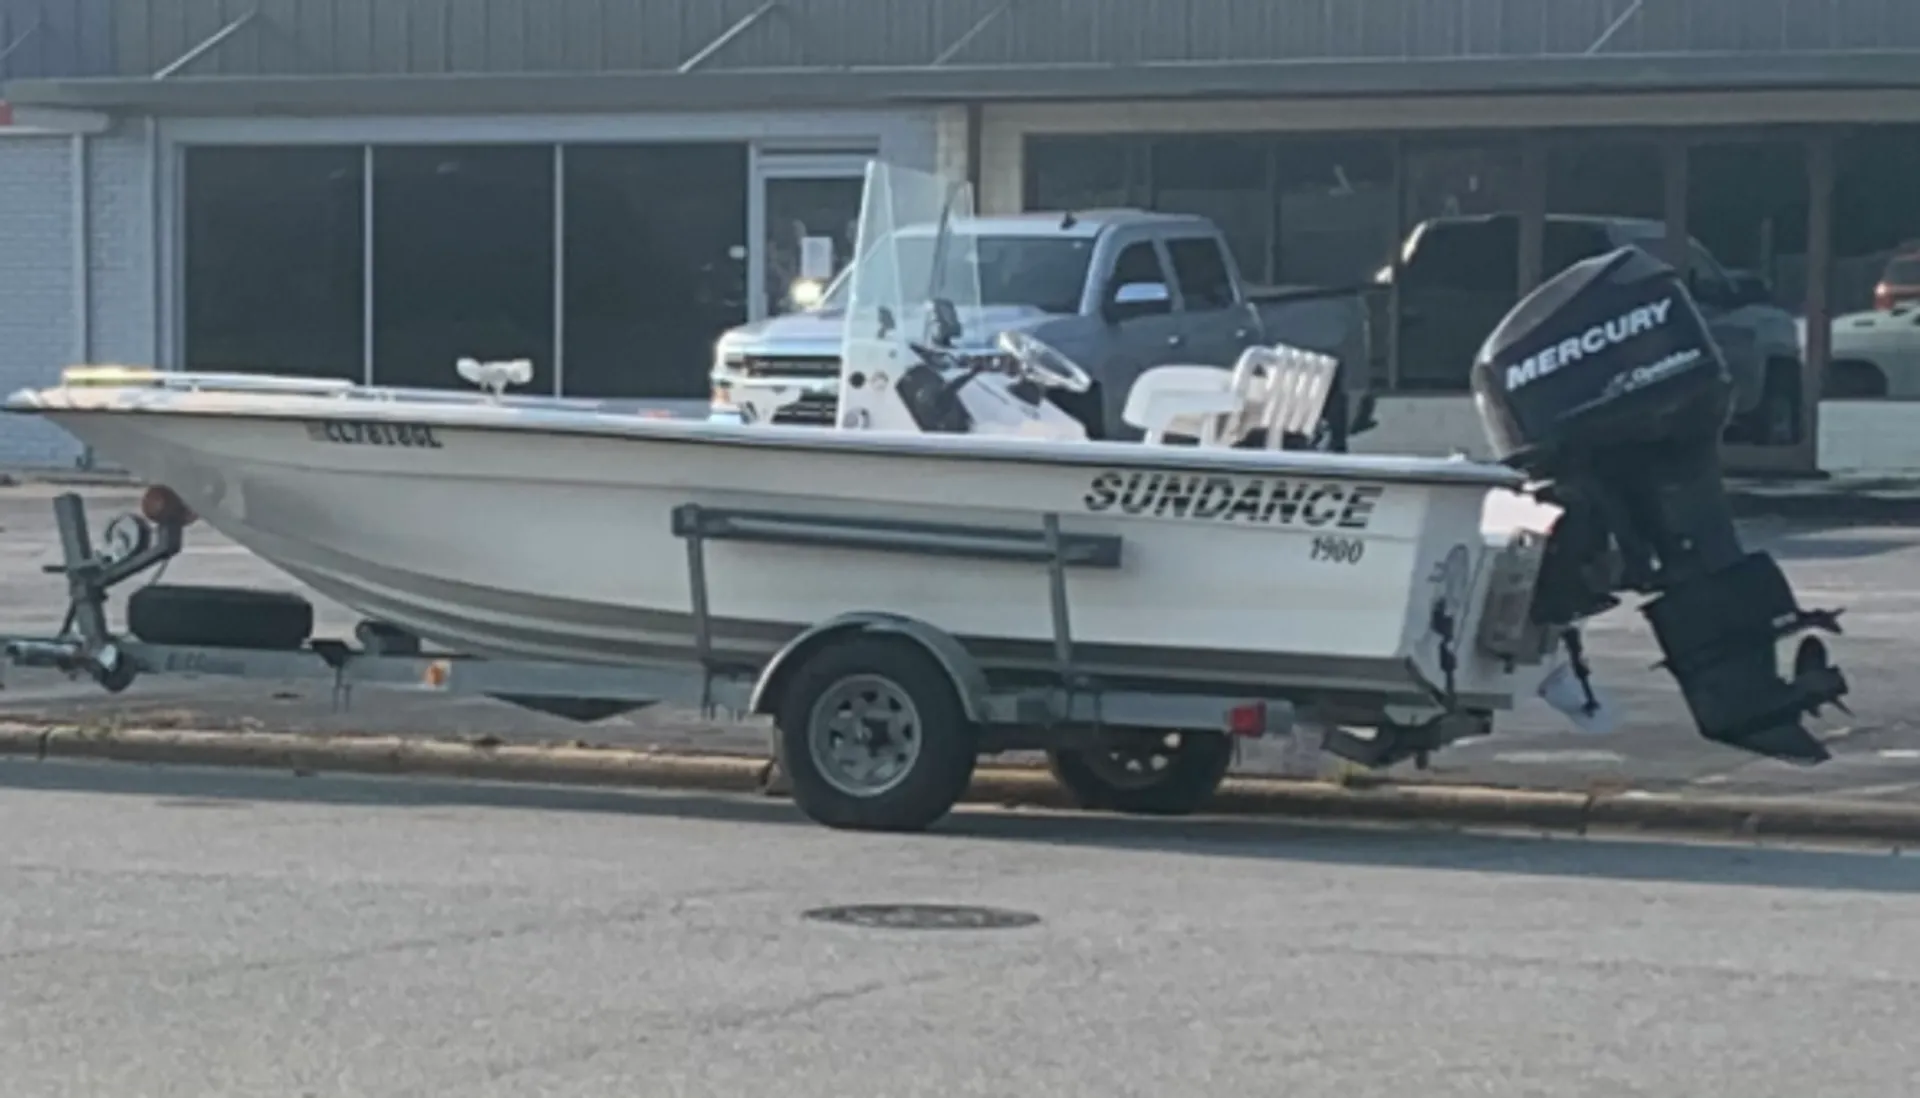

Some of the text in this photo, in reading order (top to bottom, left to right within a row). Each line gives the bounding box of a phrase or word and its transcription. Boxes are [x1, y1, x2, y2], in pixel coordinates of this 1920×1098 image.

[1505, 297, 1671, 392] MERCURY
[1084, 471, 1384, 529] SUNDANCE
[1309, 536, 1364, 565] 1900
